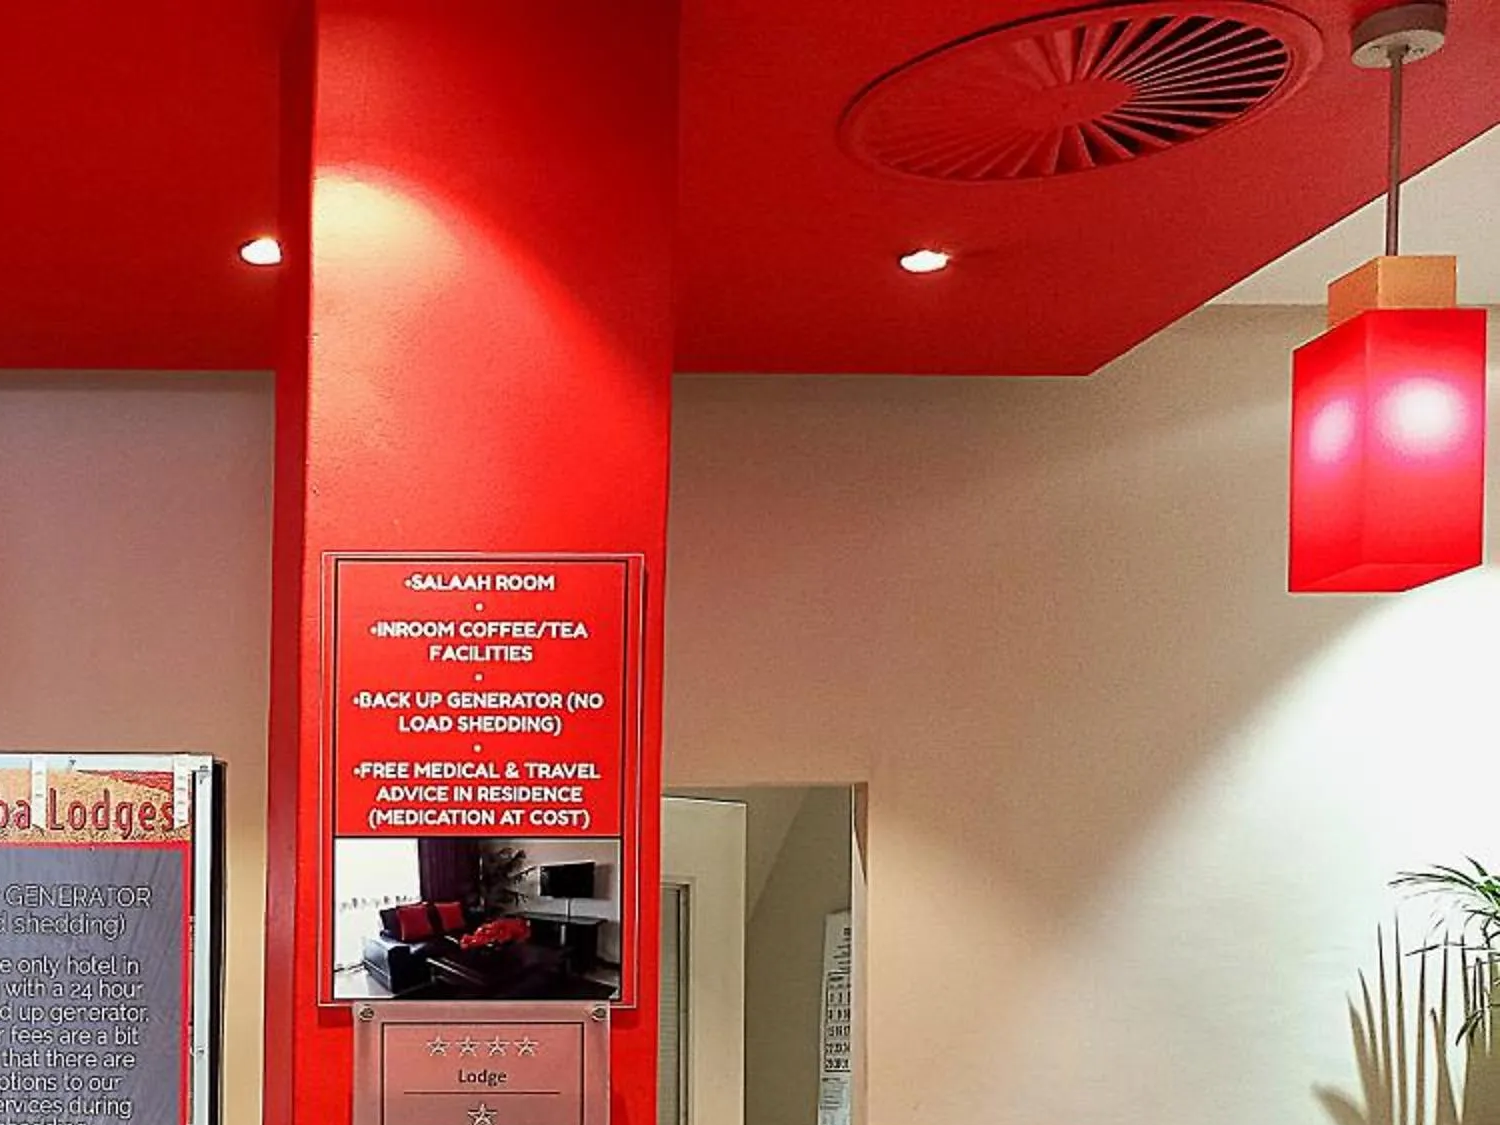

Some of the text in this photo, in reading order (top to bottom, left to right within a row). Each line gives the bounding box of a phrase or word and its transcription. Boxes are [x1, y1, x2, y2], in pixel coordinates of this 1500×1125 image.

[411, 575, 555, 591] SALAAH ROOM
[377, 622, 588, 639] INROOM COFFEE/TEA
[429, 646, 533, 661] FACILITIES
[359, 692, 604, 712] BACK UP GENERATOR (NO
[398, 716, 562, 736] LOAD SHEDDING)
[359, 763, 601, 779] FREE MEDICAL & TRAVEL
[376, 787, 582, 802] ADVICE IN RESIDENCE
[48, 786, 176, 840] Lodges
[368, 809, 590, 829] (MEDICATION AT COST)
[4, 884, 153, 908] GENERATOR
[12, 912, 126, 940] shedding)
[16, 954, 61, 979] only
[67, 954, 117, 975] hotel
[121, 955, 141, 975] in
[5, 977, 45, 996] with
[52, 983, 64, 997] a
[71, 981, 94, 1001] 24
[99, 978, 143, 997] hour
[18, 1006, 44, 1025] up
[10, 1025, 53, 1045] fees
[58, 1029, 92, 1045] are
[97, 1030, 108, 1045] a
[114, 1026, 140, 1045] bit
[2, 1049, 40, 1068] that
[45, 1049, 97, 1068] there
[102, 1053, 136, 1068] are
[64, 1074, 83, 1091] to
[87, 1076, 122, 1091] our
[458, 1069, 507, 1086] Lodge
[68, 1096, 134, 1119] during
